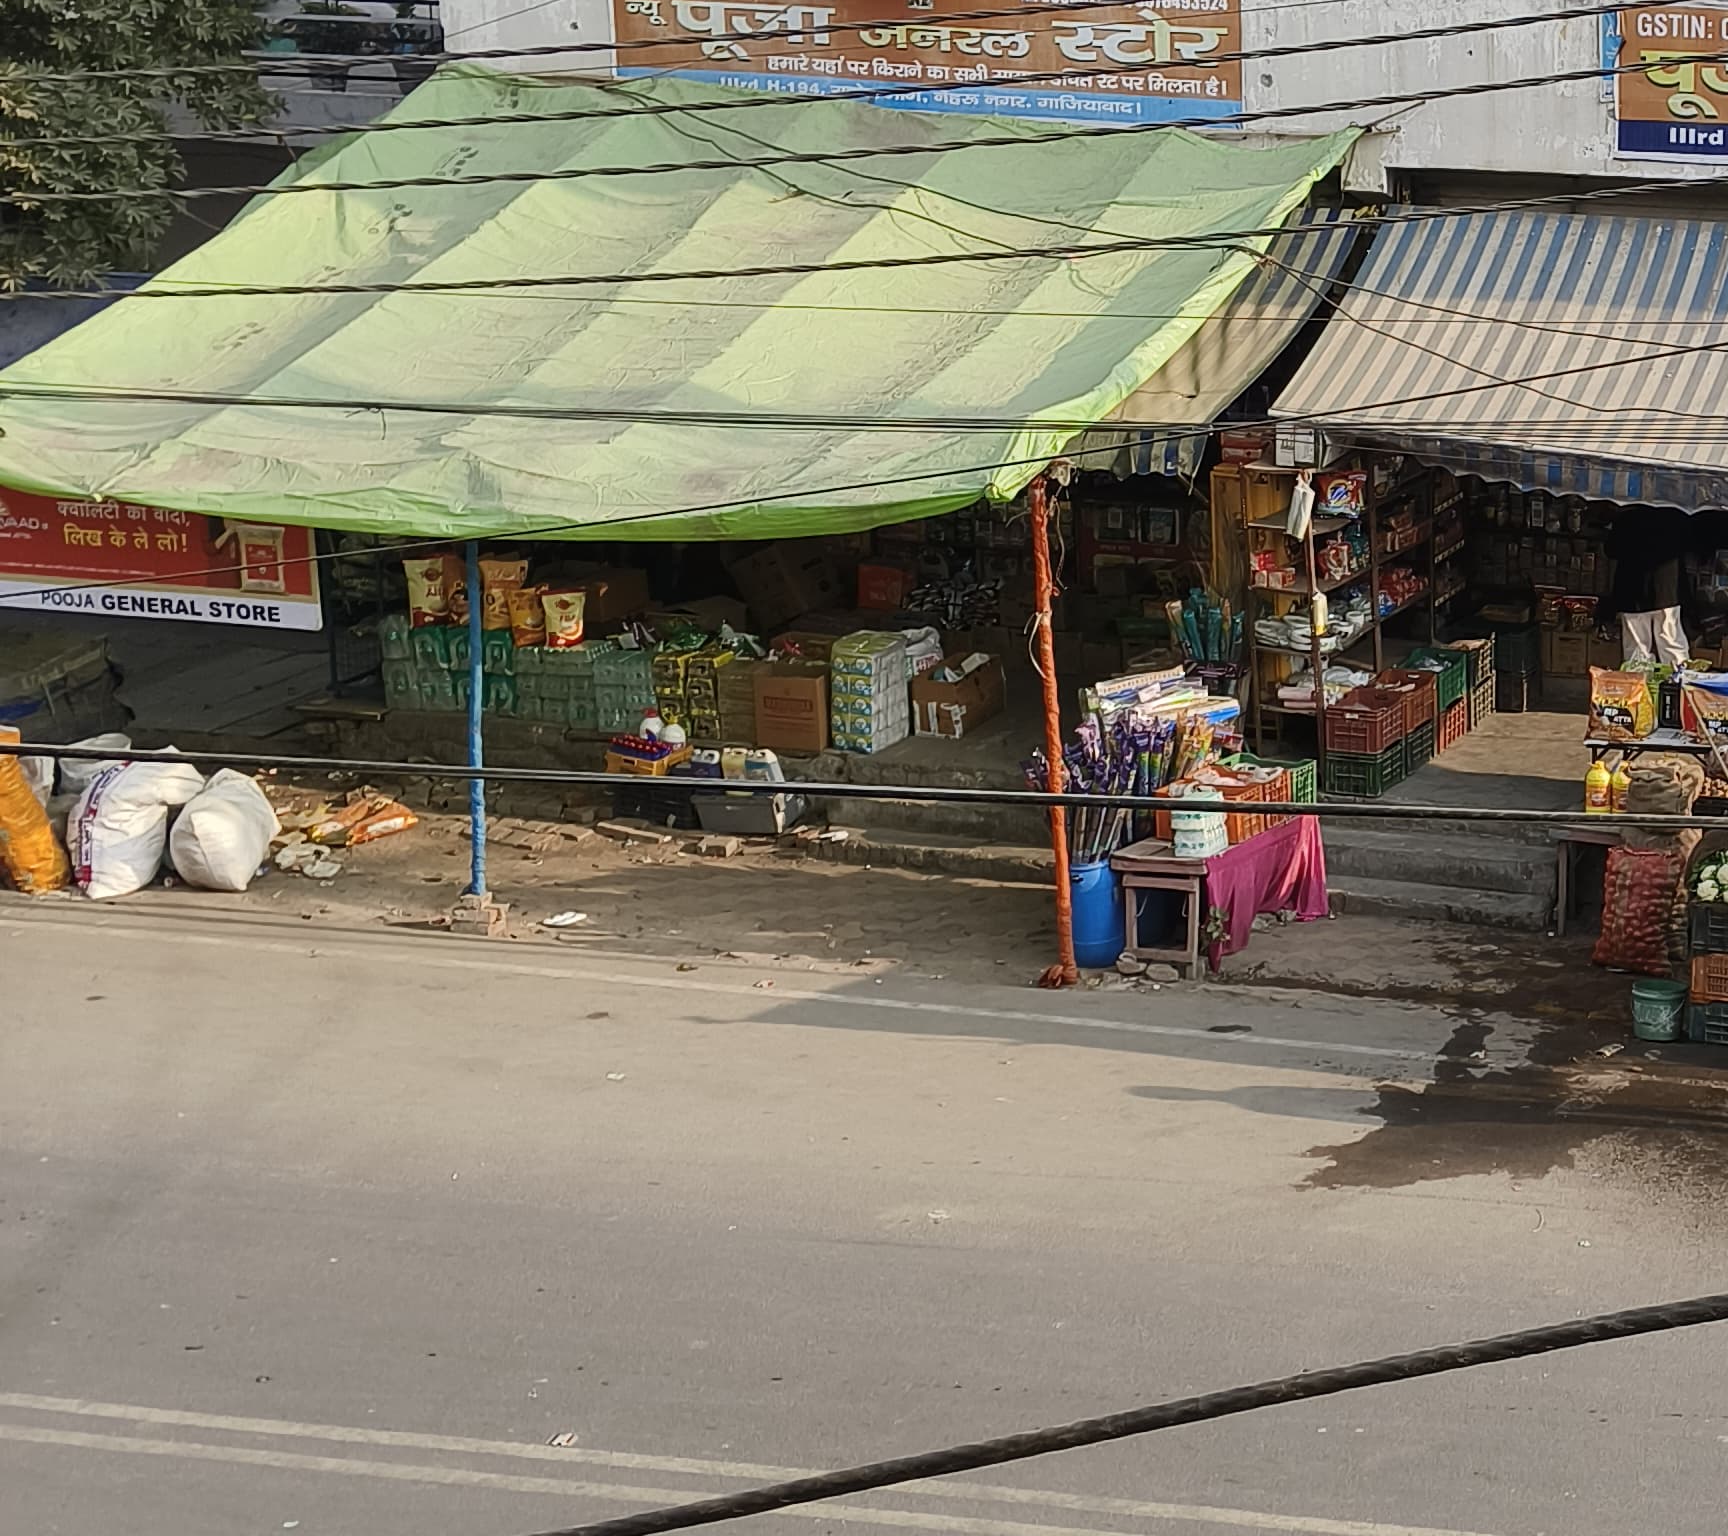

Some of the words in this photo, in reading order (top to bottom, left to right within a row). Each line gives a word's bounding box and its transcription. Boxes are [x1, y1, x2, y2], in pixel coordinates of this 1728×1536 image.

[857, 20, 1036, 59] जनरल
[1051, 8, 1229, 67] स्टोर
[1636, 12, 1714, 41] GSTIN:
[766, 54, 810, 72] हमारे
[846, 59, 869, 76] पर
[872, 57, 923, 80] किराने
[925, 63, 951, 83] का
[953, 64, 989, 83] सभी
[1121, 74, 1145, 93] पर
[1147, 72, 1202, 96] मिलता
[63, 521, 104, 548] लिख
[108, 524, 127, 549] के
[132, 526, 149, 551] ले
[41, 590, 95, 610] POOJA
[101, 593, 203, 617] GENERAL
[208, 601, 282, 623] STORE
